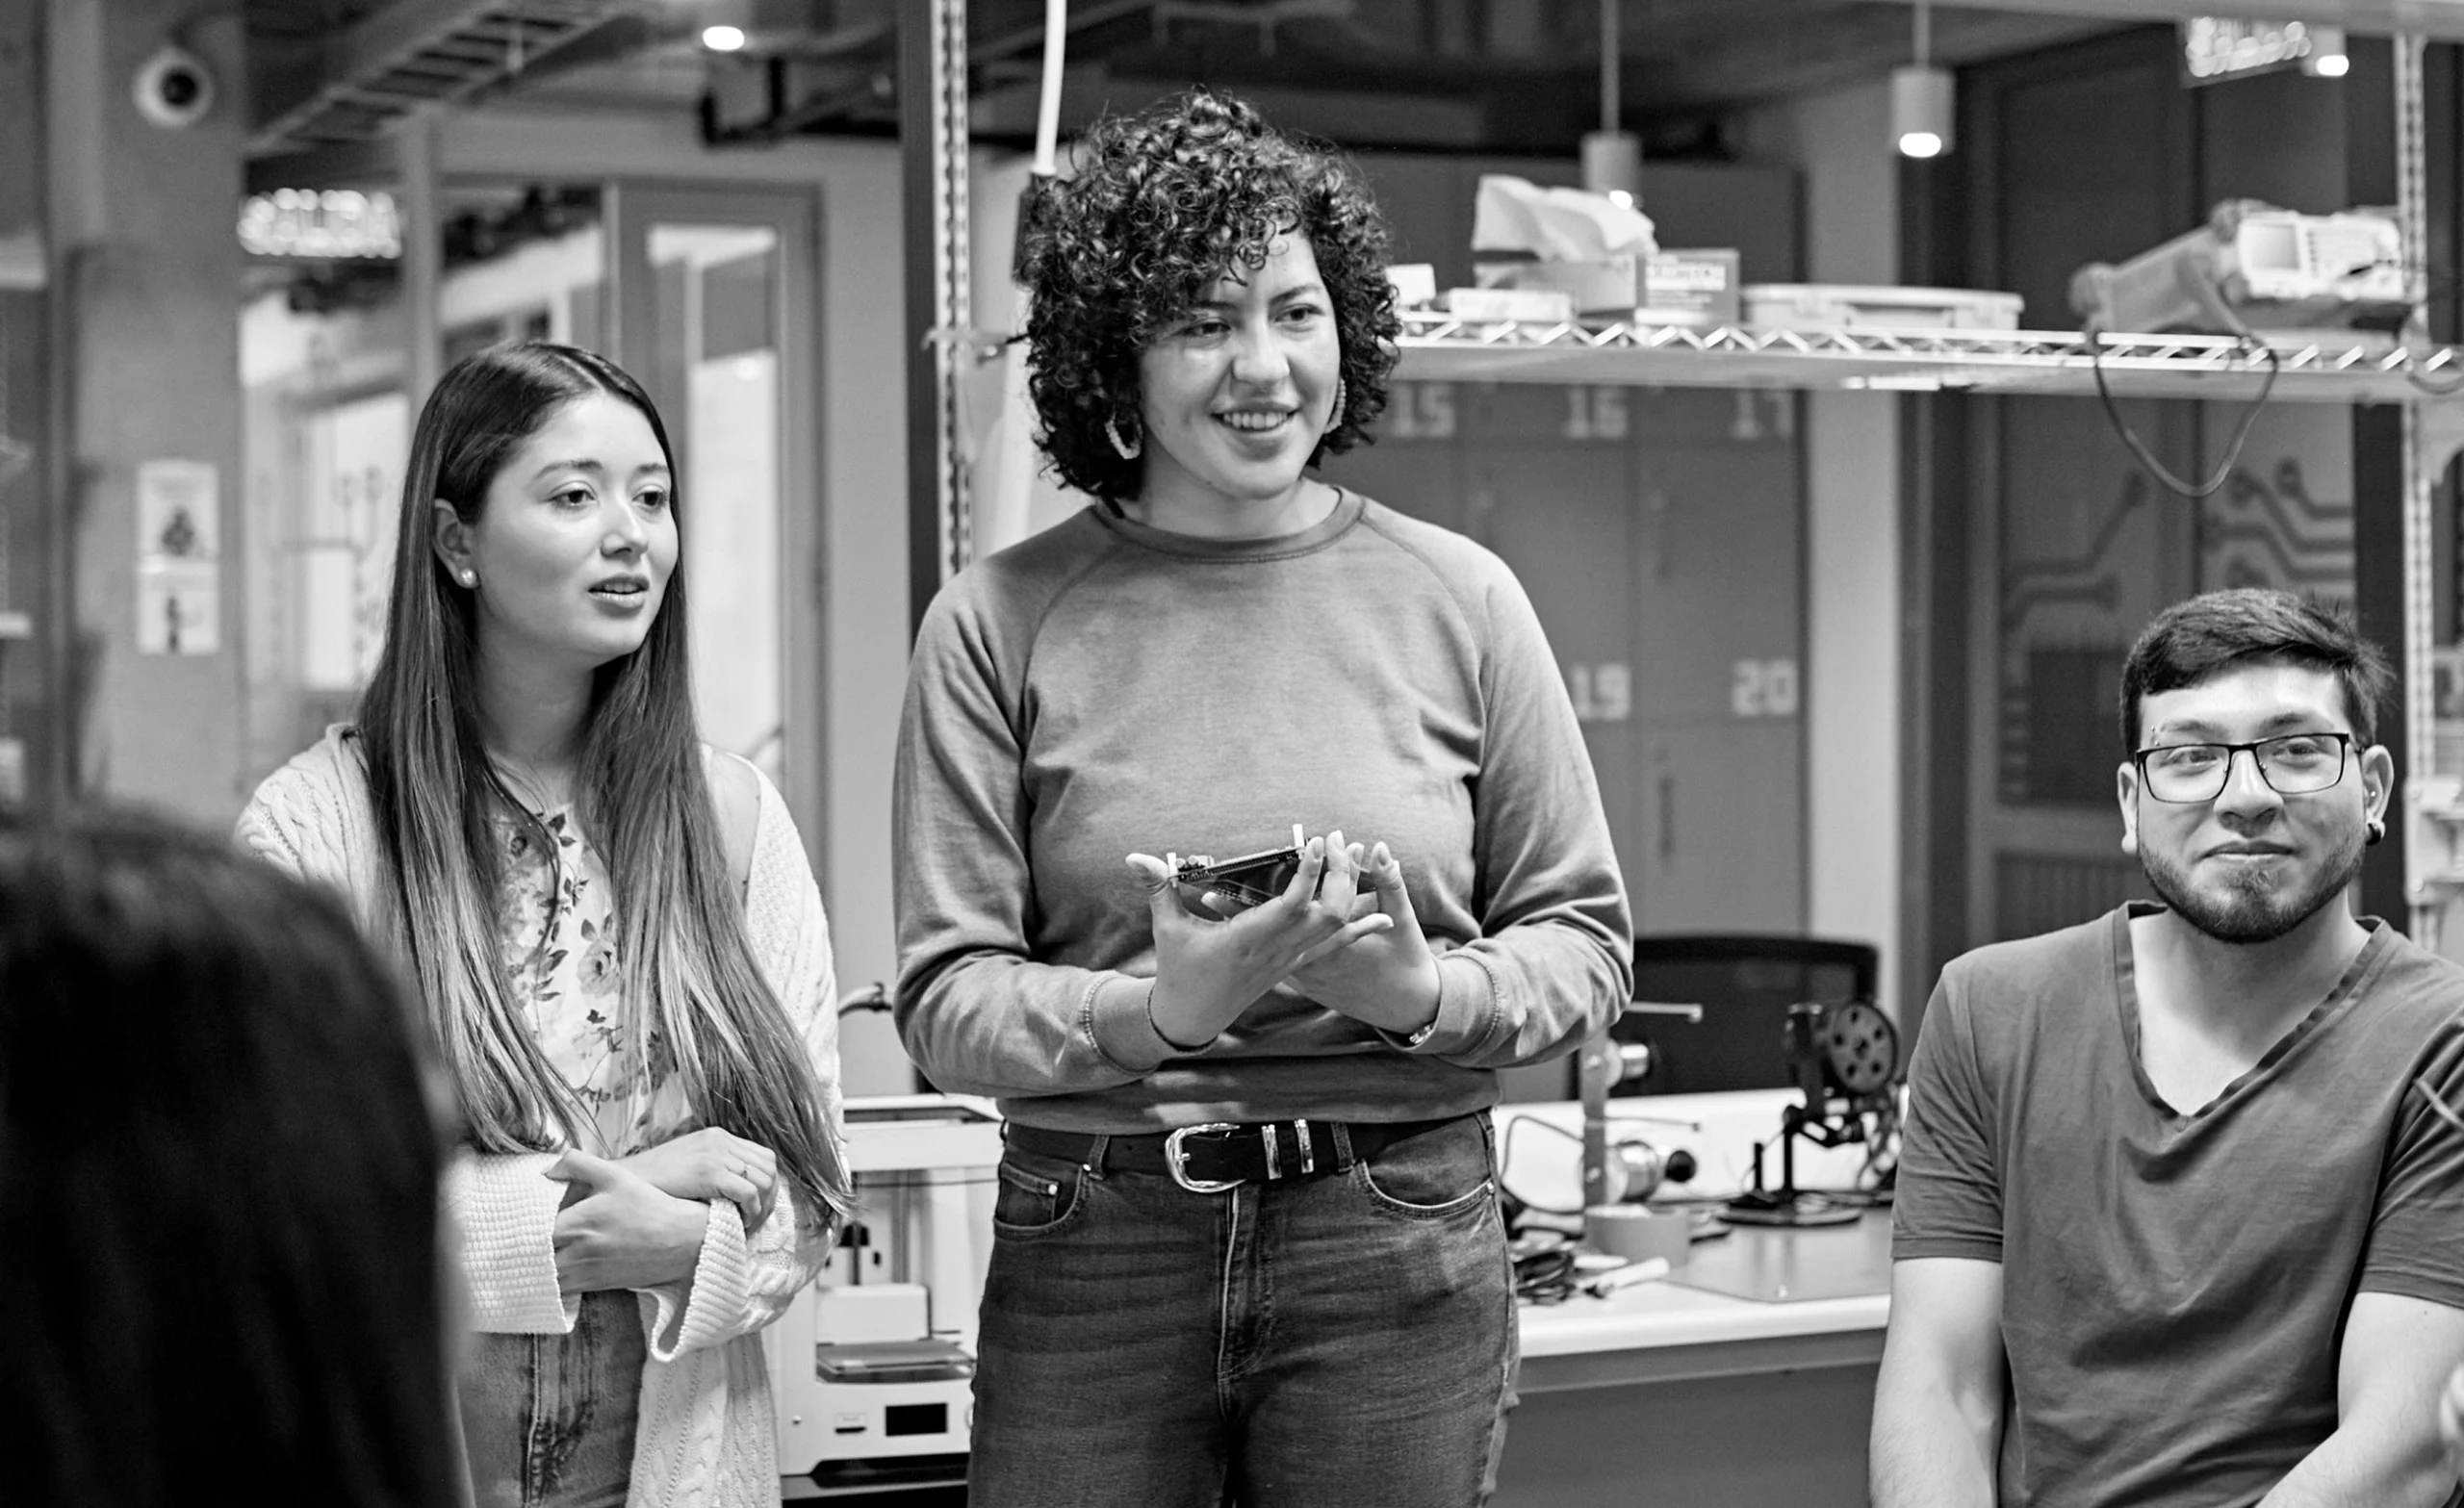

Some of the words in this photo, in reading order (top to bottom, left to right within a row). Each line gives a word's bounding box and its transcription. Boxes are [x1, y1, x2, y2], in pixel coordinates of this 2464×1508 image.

[1392, 381, 1455, 439] 15
[1571, 664, 1632, 720] 19
[1732, 659, 1798, 715] 20
